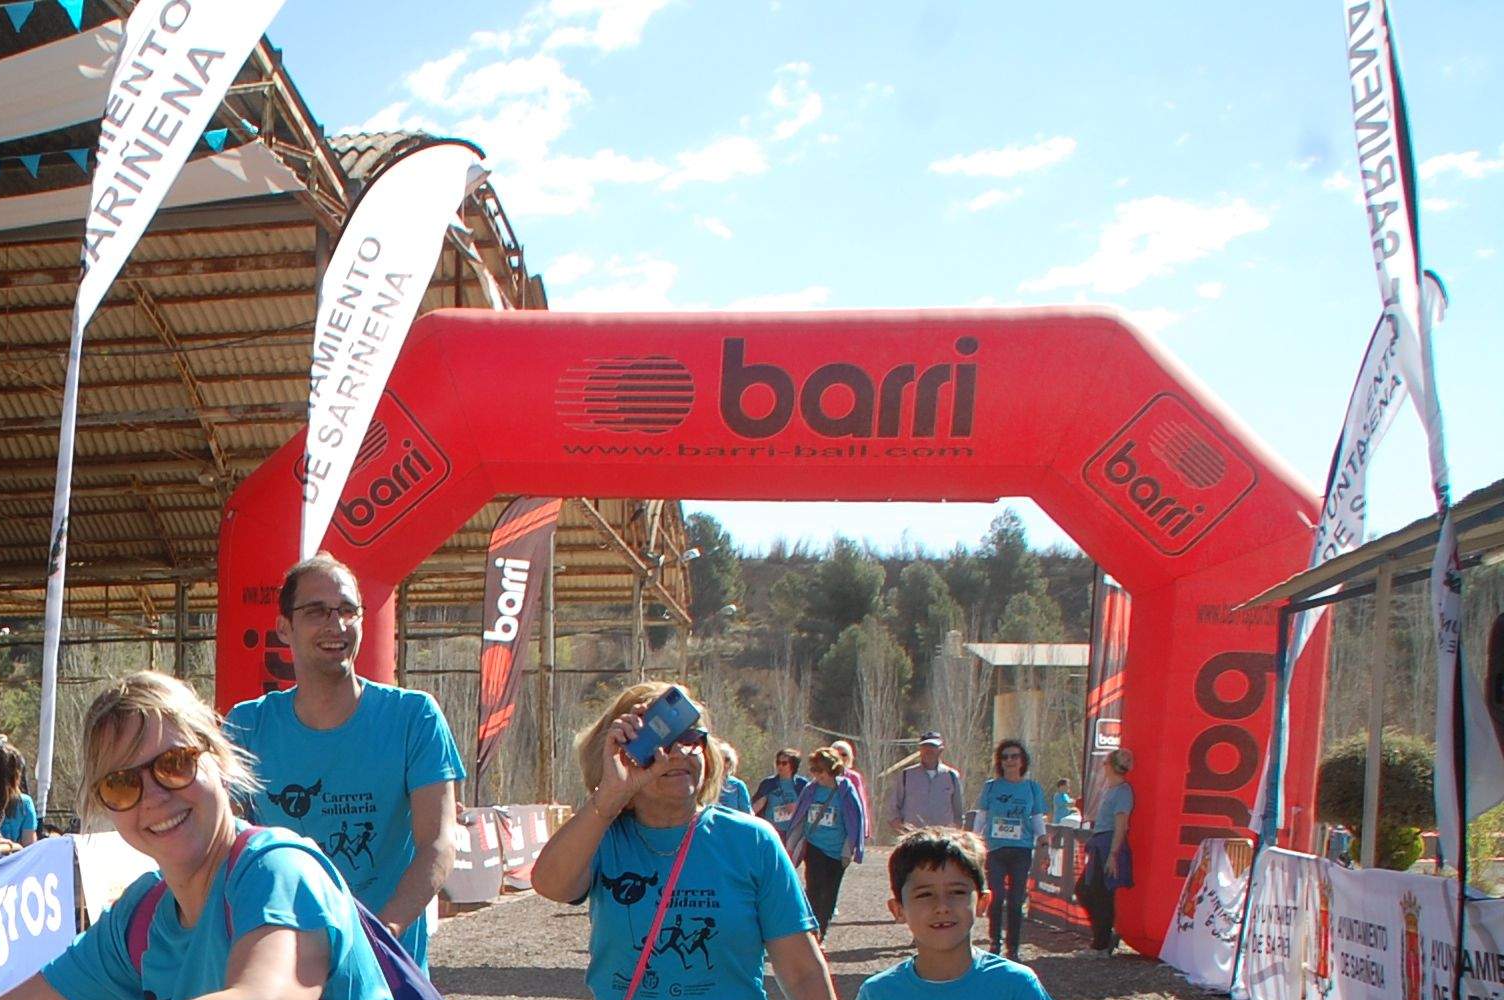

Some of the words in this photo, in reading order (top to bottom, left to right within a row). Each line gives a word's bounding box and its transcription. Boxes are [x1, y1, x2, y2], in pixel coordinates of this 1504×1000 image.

[95, 0, 193, 166] IENTO
[83, 47, 226, 268] ARIÑENA
[718, 335, 981, 441] barri
[337, 438, 434, 528] barri
[1103, 439, 1207, 539] barri
[483, 556, 531, 642] barri
[321, 791, 373, 804] Carrera
[321, 801, 377, 817] solidaria
[1430, 938, 1504, 984] AYUNAMIE
